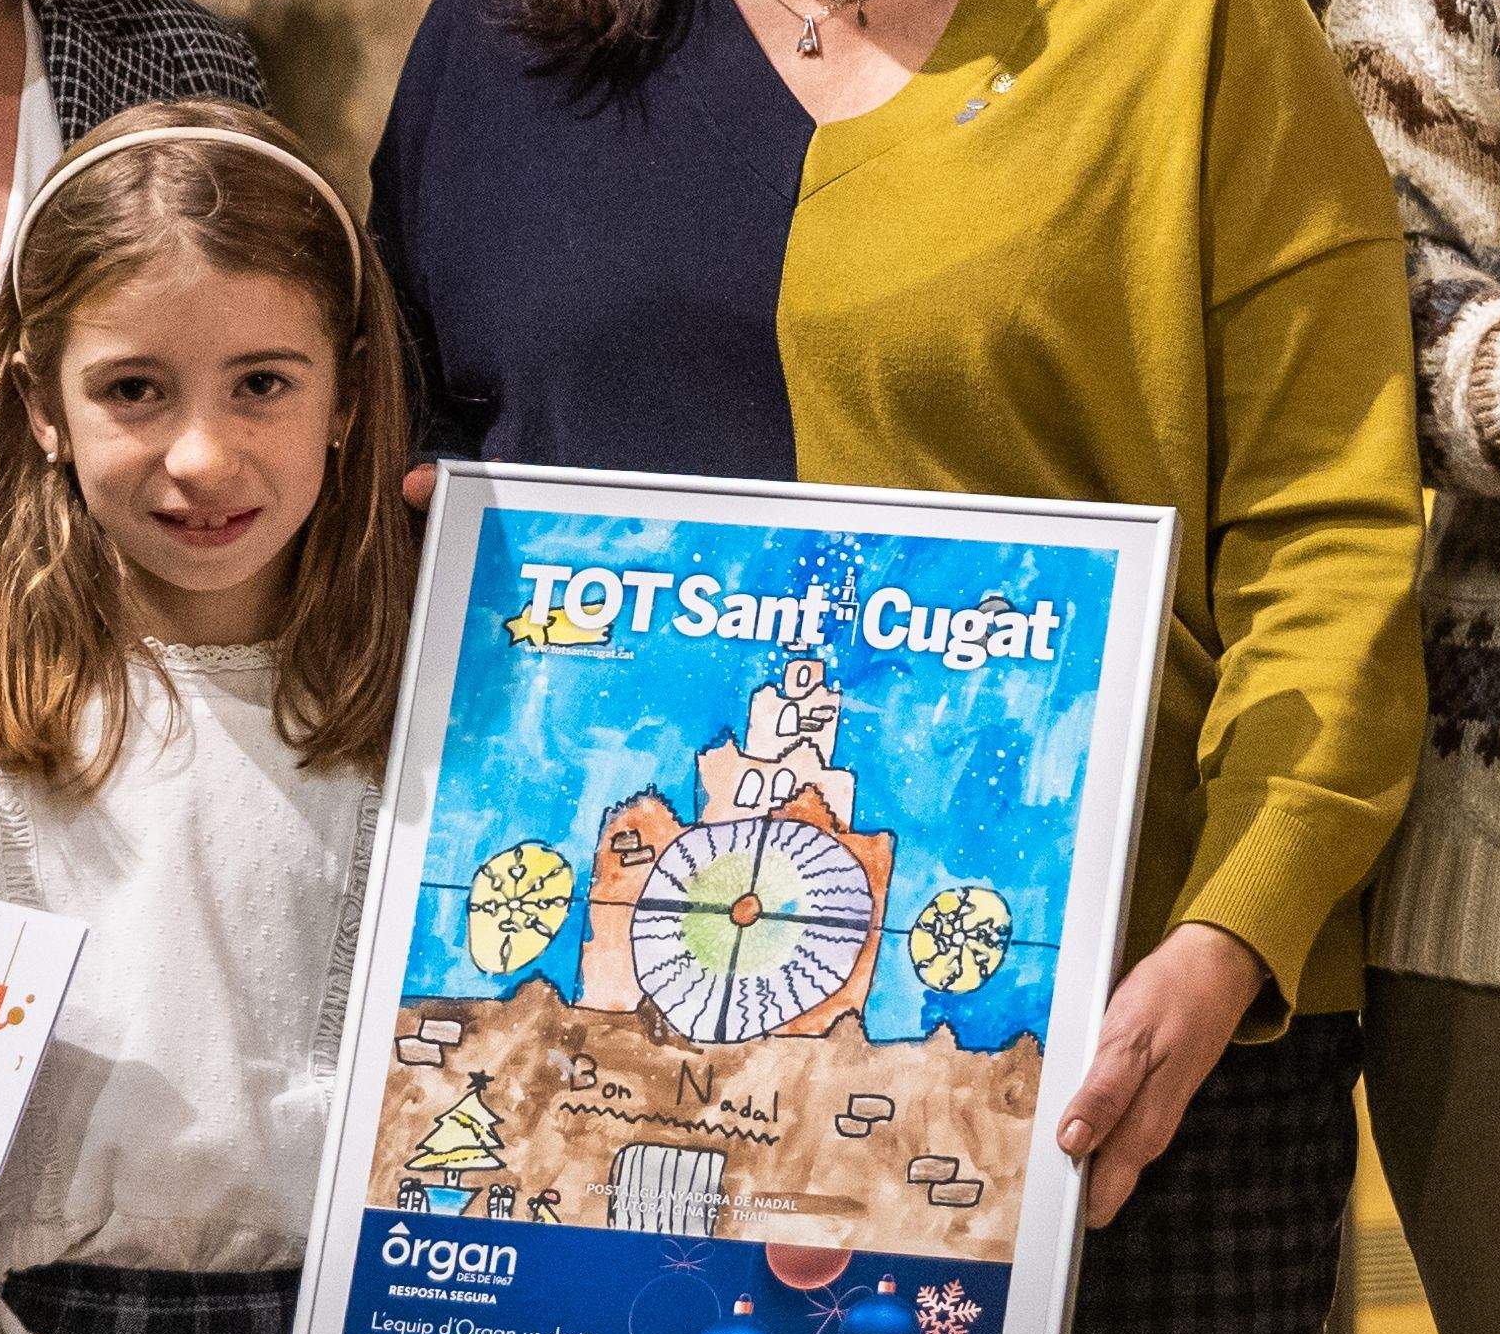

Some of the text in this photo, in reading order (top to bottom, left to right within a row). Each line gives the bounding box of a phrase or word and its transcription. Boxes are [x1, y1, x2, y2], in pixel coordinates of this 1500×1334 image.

[519, 564, 1061, 669] TOT Sant Cugat
[570, 1053, 778, 1123] Bon Nadal
[586, 1184, 798, 1211] POSTAL GUANYADORA DE NADAL
[672, 1205, 703, 1217] GINA
[732, 1210, 767, 1222] THAU
[456, 1273, 513, 1286] DES 1967
[388, 1285, 497, 1305] RESPOSTA SEGURA
